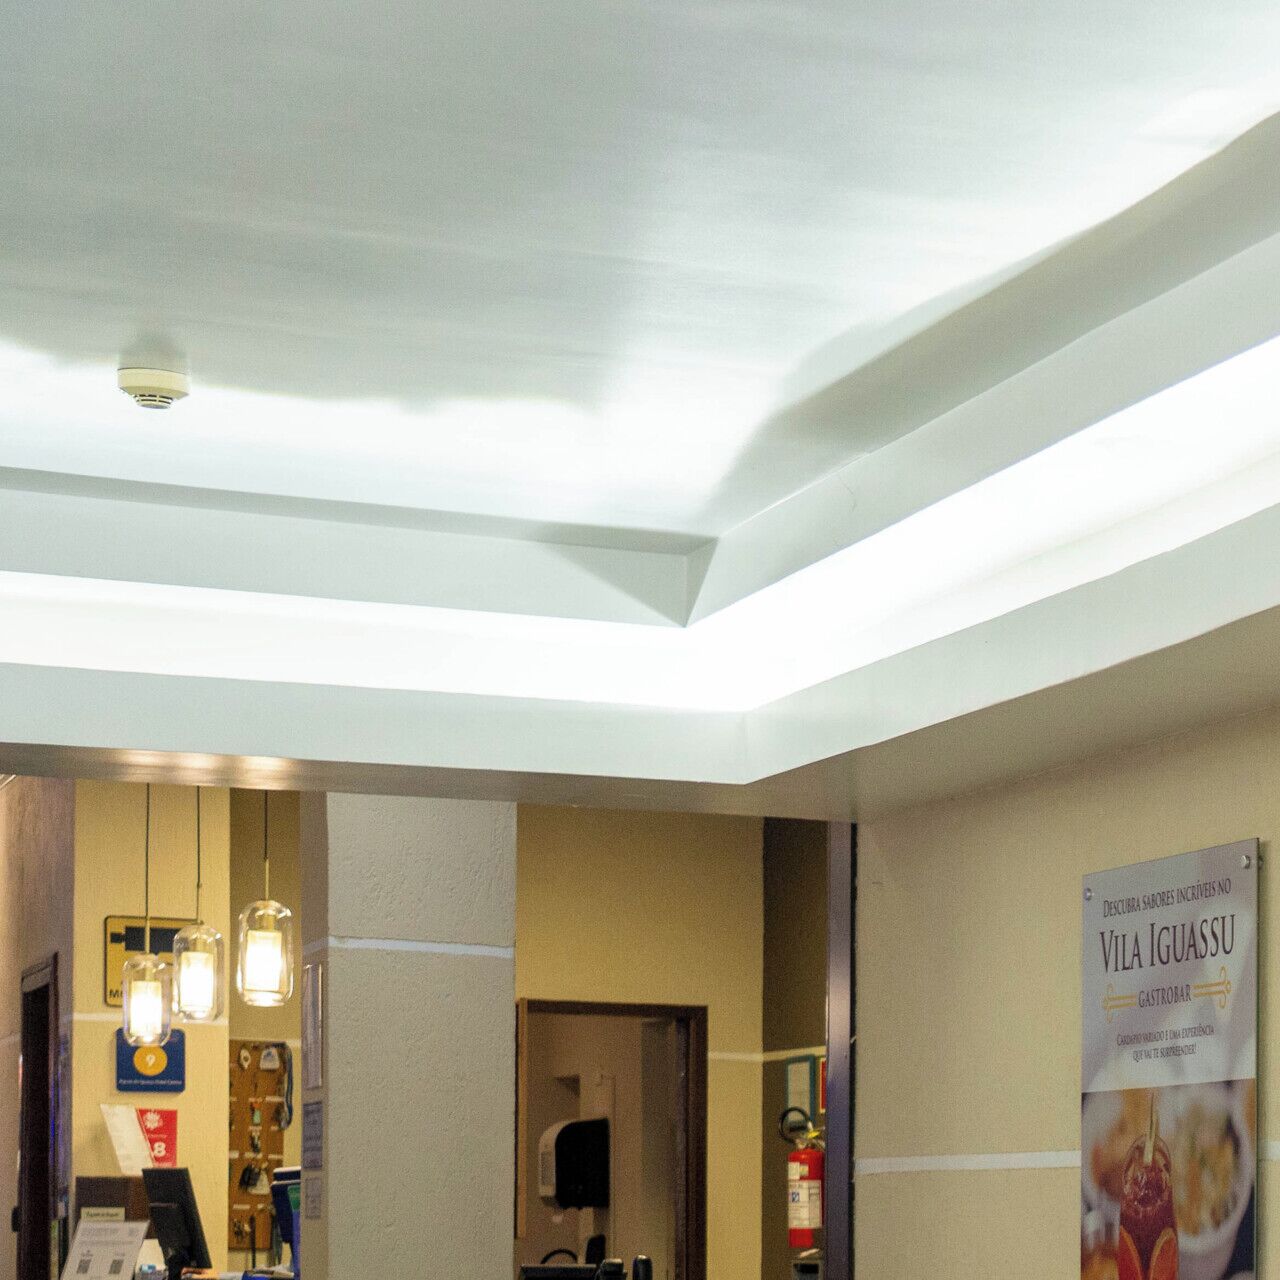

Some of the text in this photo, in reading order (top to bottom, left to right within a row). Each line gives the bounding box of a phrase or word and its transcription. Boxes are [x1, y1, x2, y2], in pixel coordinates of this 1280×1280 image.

[1103, 878, 1231, 918] DESCUBRA SABORES INCRÍVEIS NO
[1100, 914, 1235, 973] VILA IGUASSU
[1138, 984, 1192, 1008] GASTROBAR
